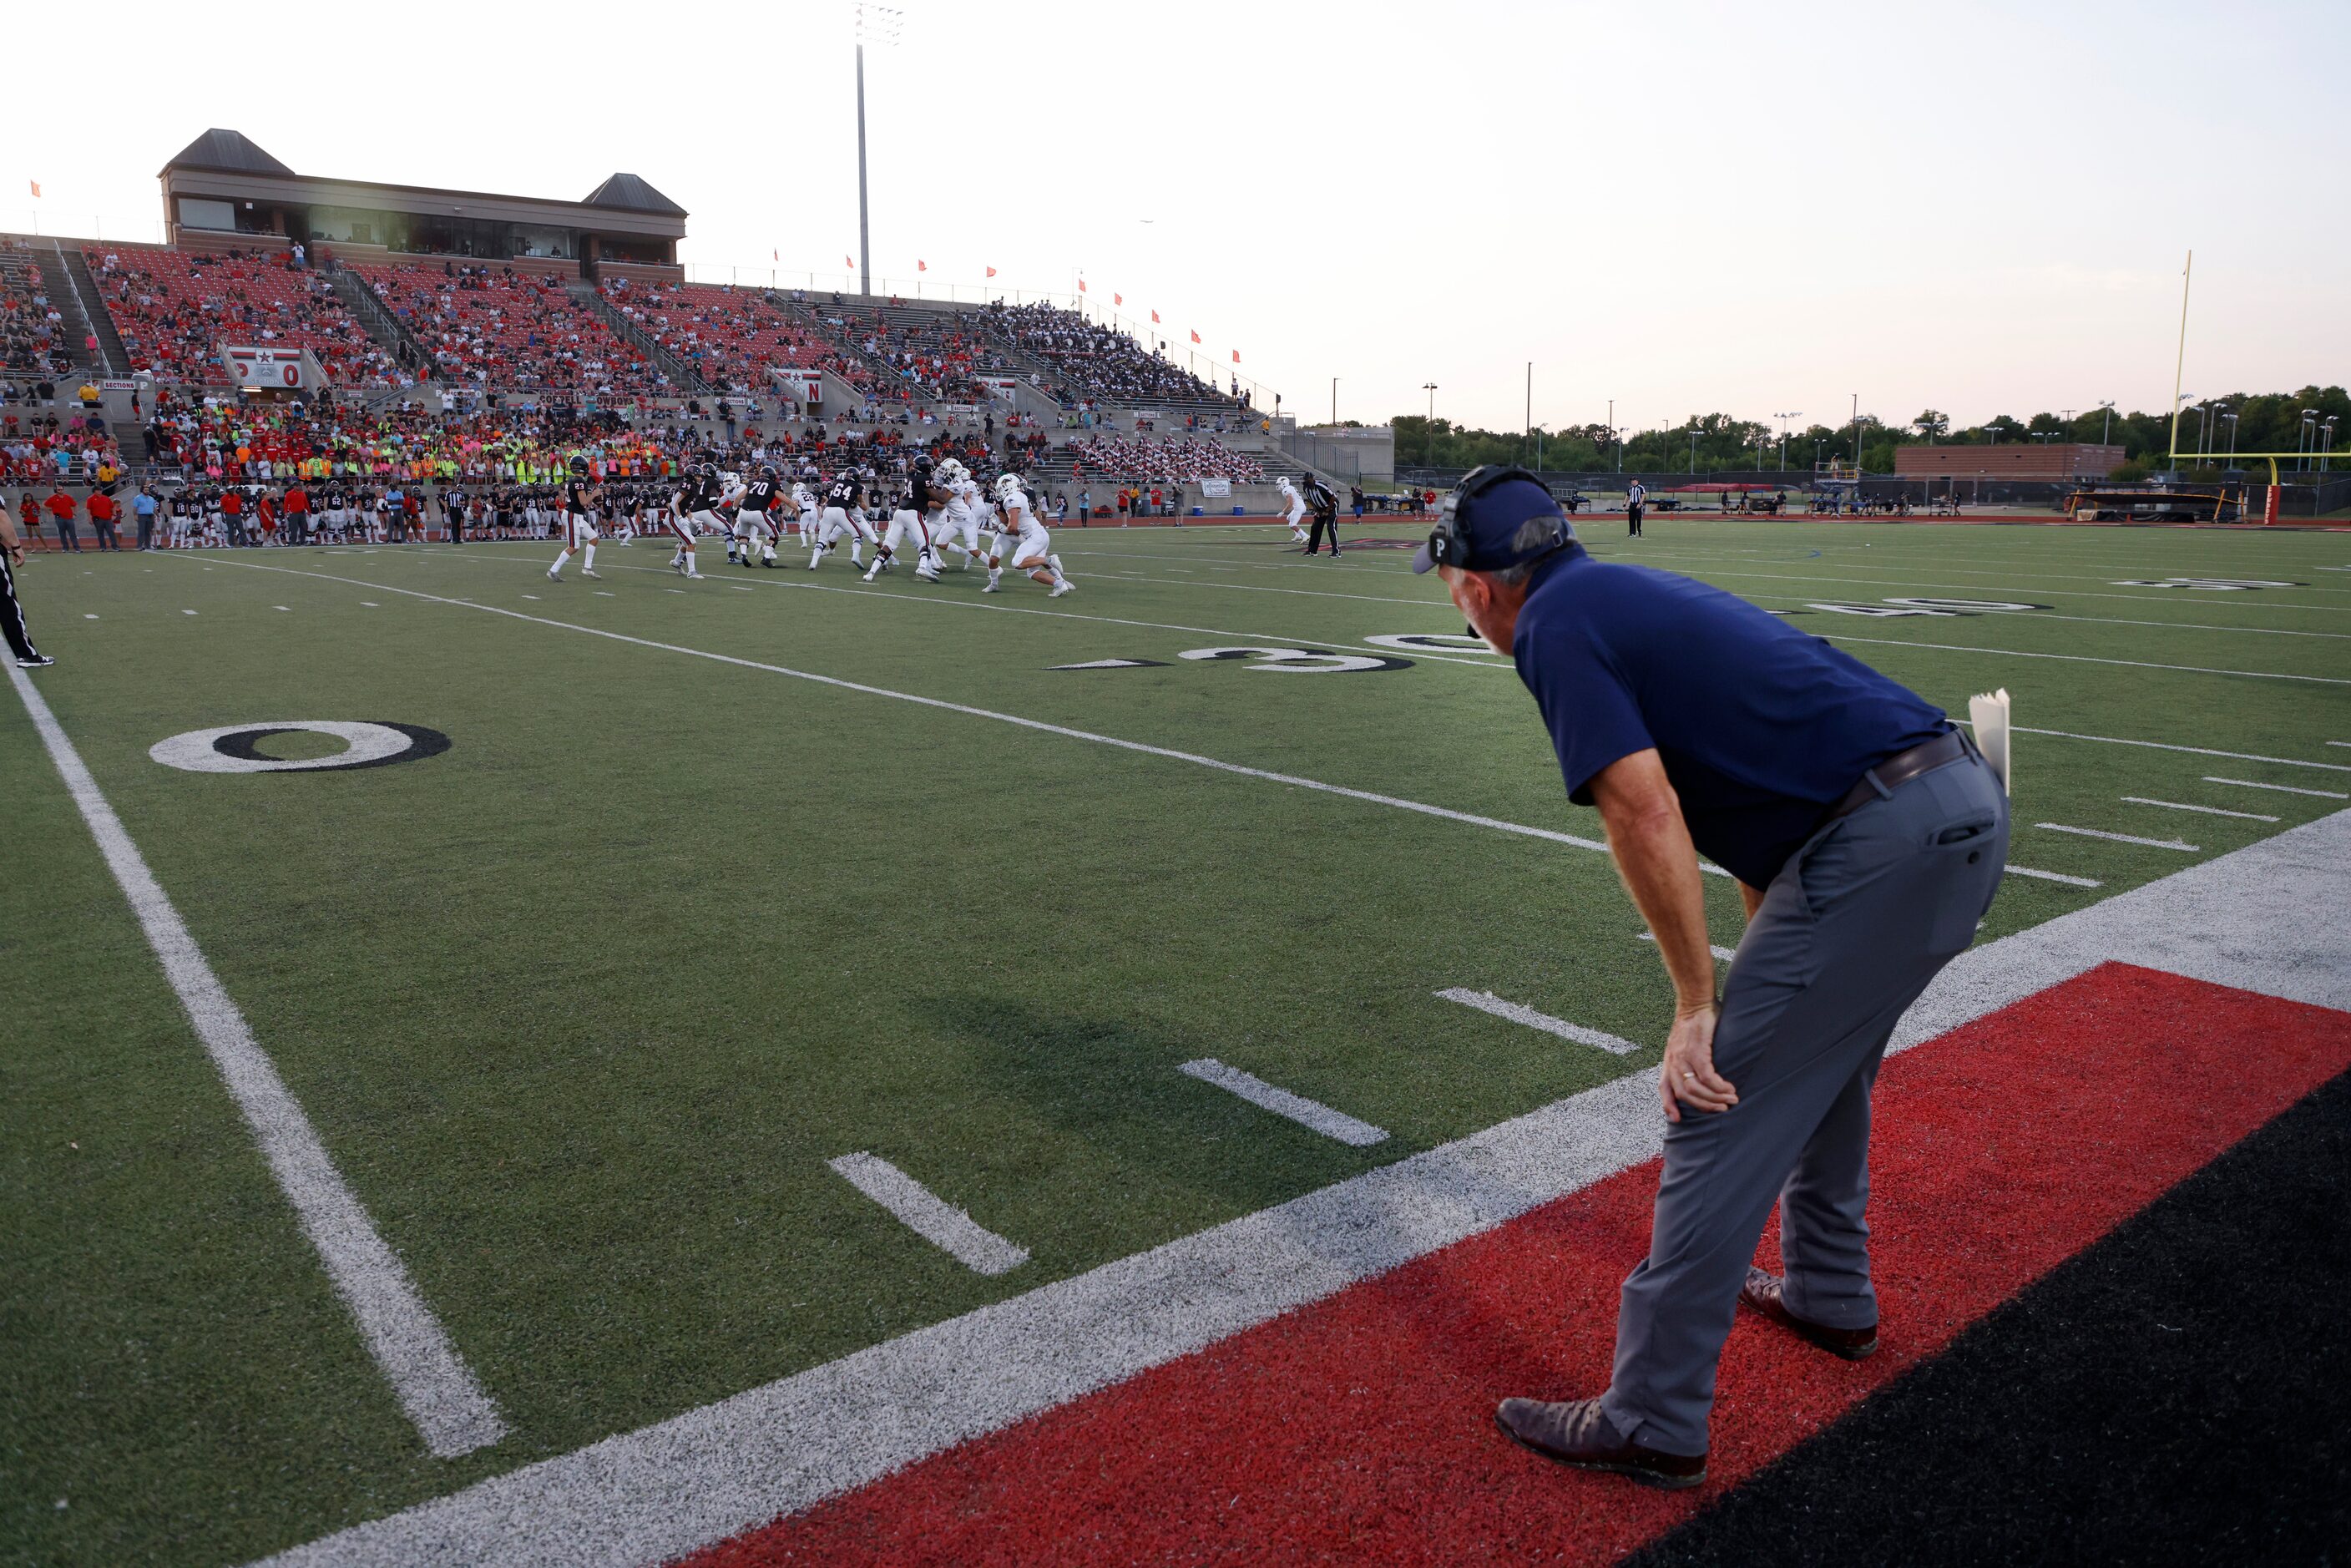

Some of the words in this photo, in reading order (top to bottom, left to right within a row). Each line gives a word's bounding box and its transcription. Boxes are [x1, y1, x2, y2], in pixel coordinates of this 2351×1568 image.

[139, 381, 148, 390] P
[435, 389, 442, 397] P
[808, 382, 820, 402] N
[748, 481, 769, 496] 70
[832, 483, 852, 501] 64
[176, 503, 185, 513] 18
[331, 498, 341, 506] 62
[1436, 538, 1446, 558] P
[148, 720, 452, 774] 0
